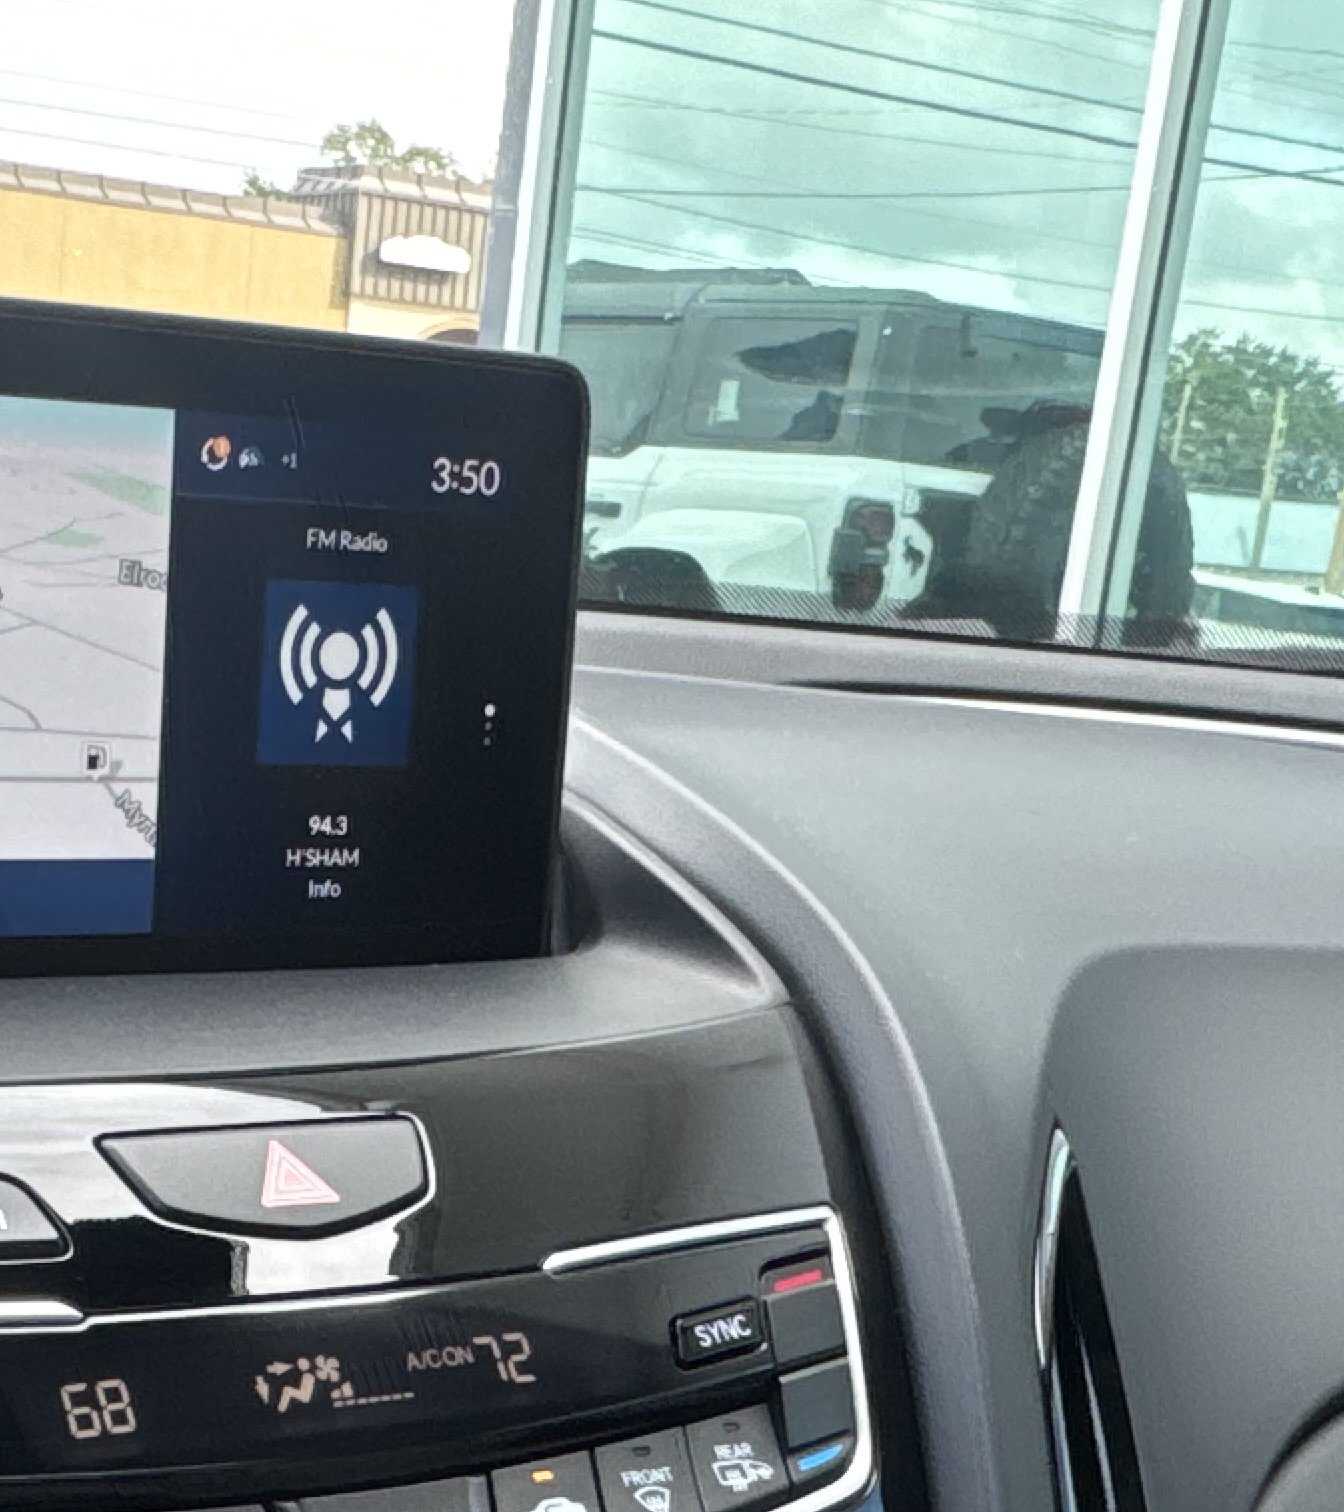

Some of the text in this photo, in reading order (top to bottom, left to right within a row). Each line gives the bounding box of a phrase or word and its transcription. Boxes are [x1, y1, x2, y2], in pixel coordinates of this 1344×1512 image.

[430, 456, 502, 496] 3:50
[306, 527, 388, 553] FM Radio
[308, 814, 348, 836] 94.3
[308, 879, 342, 899] Info
[694, 1314, 752, 1348] SYNC
[472, 1332, 537, 1384] 72
[60, 1378, 136, 1440] 68
[713, 1441, 754, 1460] REAR
[620, 1466, 674, 1488] FRONT
